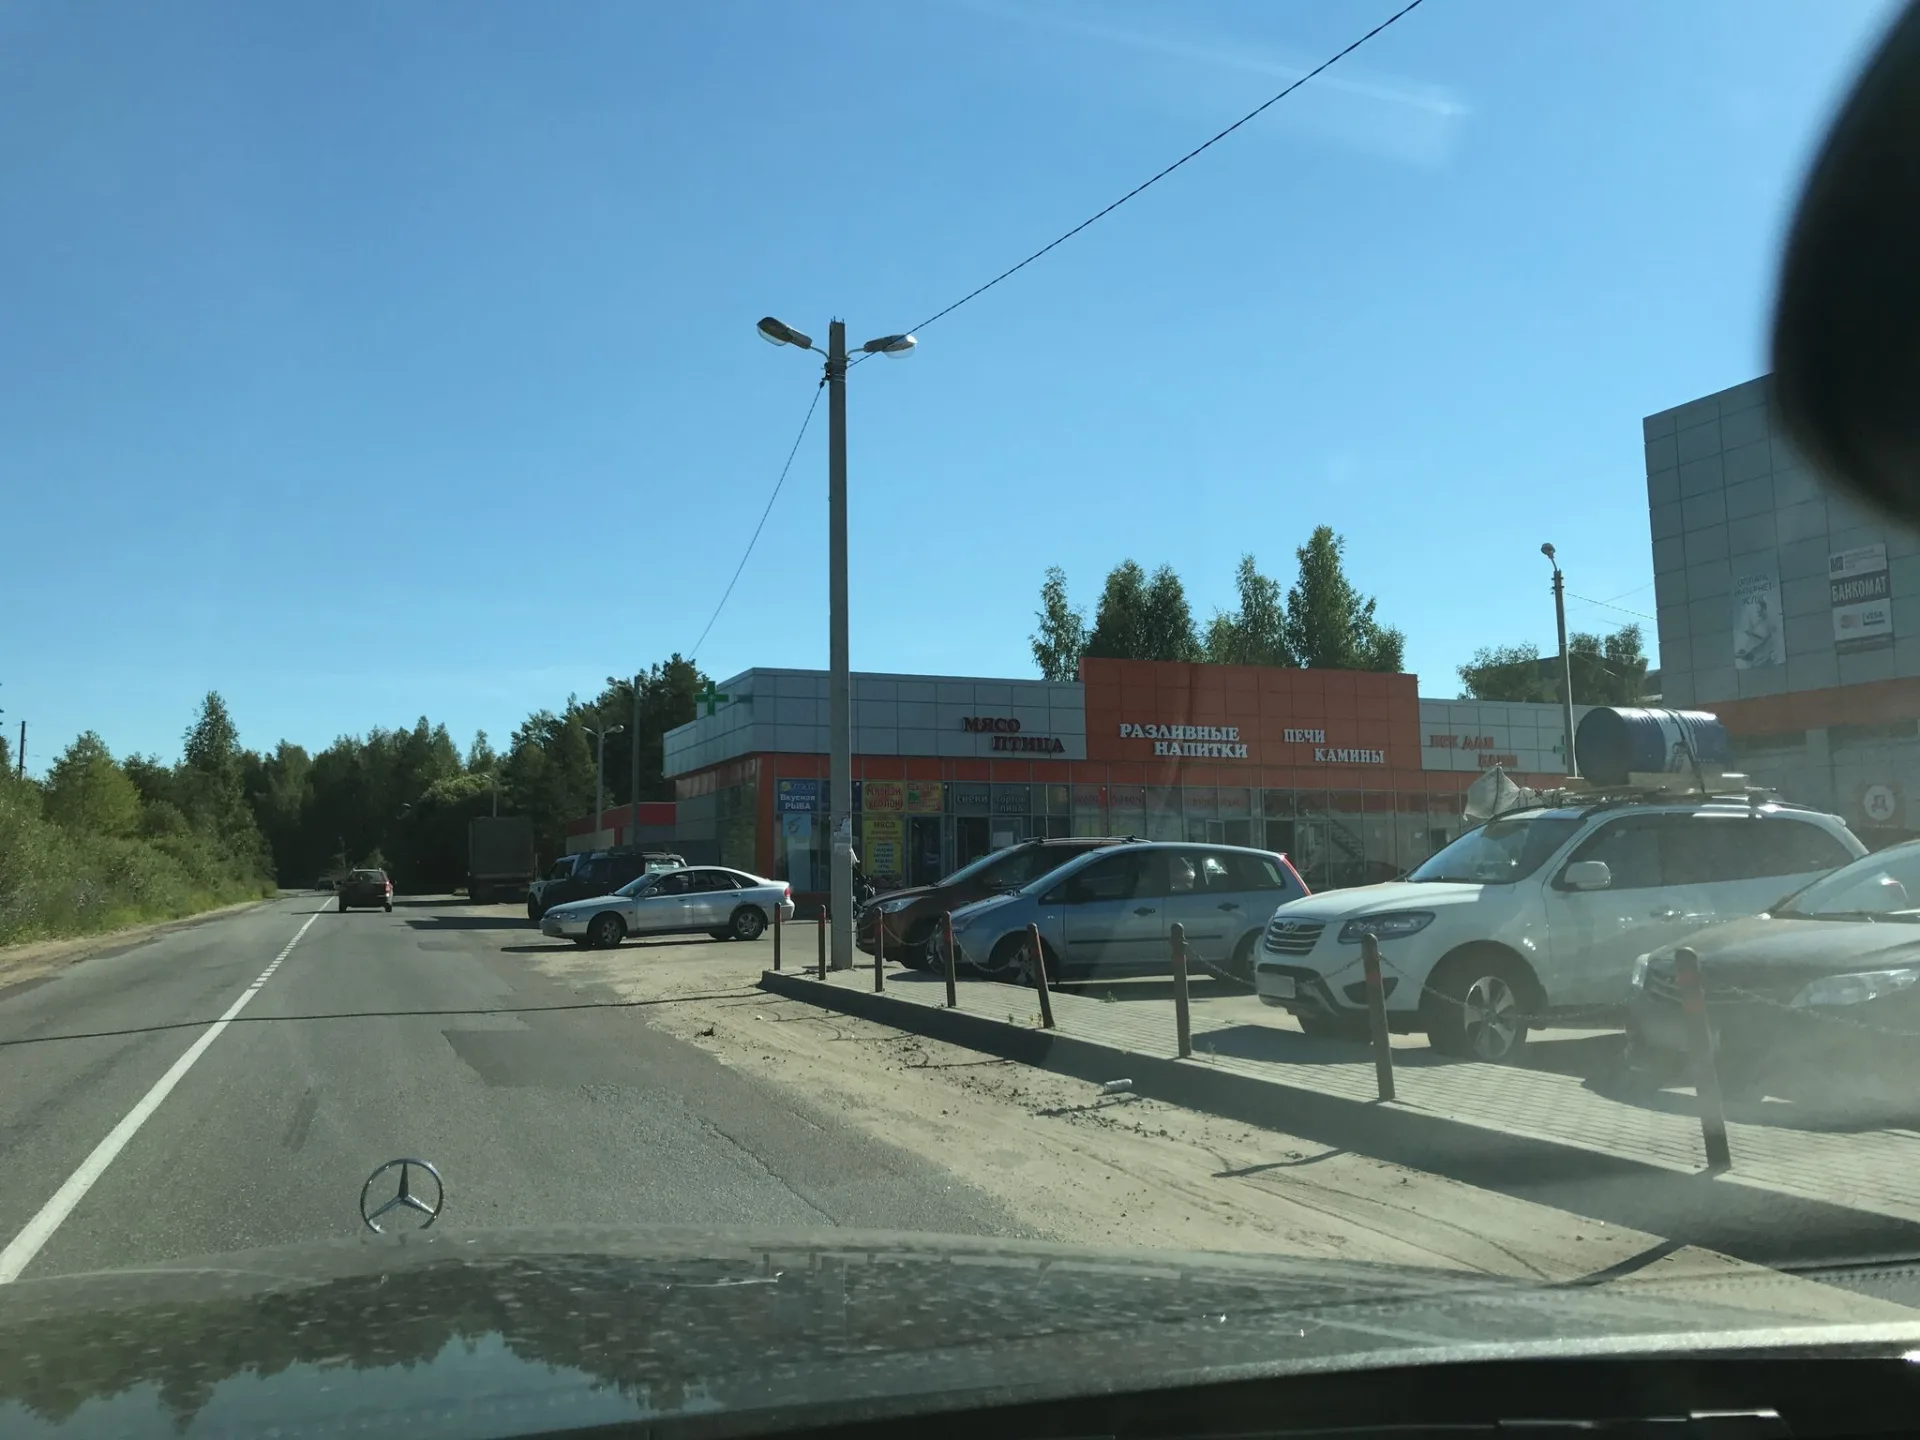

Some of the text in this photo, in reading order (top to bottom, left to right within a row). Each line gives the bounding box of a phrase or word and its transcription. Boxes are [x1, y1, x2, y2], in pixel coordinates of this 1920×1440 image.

[1831, 576, 1886, 602] БАНКОМАТ
[962, 716, 1021, 732] МЯСО
[1119, 723, 1240, 741] РАЗЛИВНЫЕ
[991, 735, 1065, 753] ПТИЦА
[1283, 729, 1325, 743] ПЕЧИ
[1154, 741, 1248, 758] НАПИТКИ
[1314, 748, 1385, 763] КАМИНЫ
[780, 793, 816, 802] Вкусная
[784, 802, 811, 810] РЫБА
